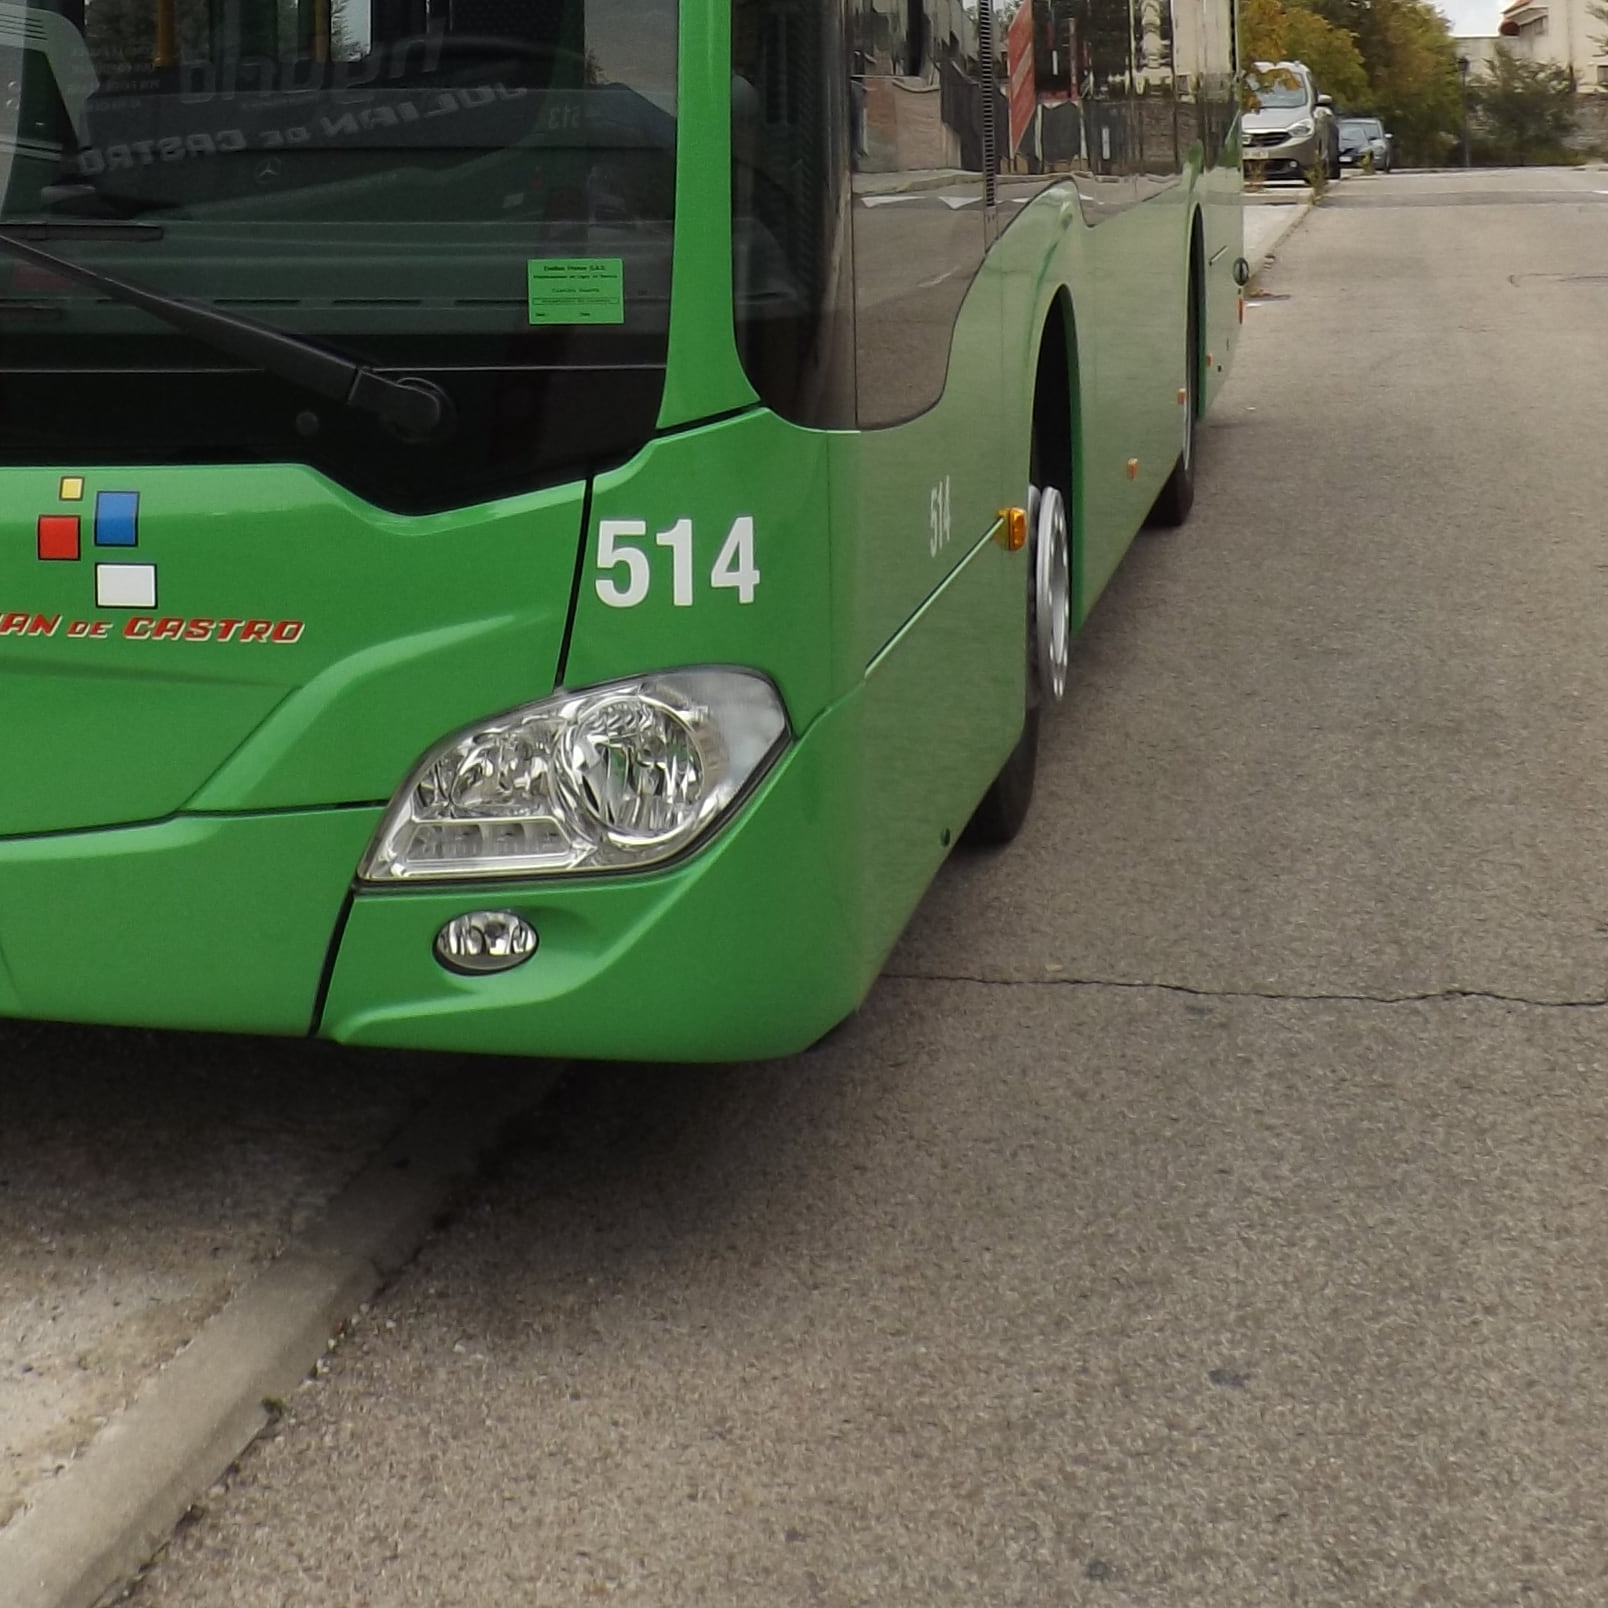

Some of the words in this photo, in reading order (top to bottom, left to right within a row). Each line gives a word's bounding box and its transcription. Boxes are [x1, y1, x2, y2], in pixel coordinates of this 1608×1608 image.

[929, 474, 952, 559] 514
[595, 515, 761, 608] 514
[67, 619, 115, 640] DE
[121, 616, 306, 644] CASTRO
